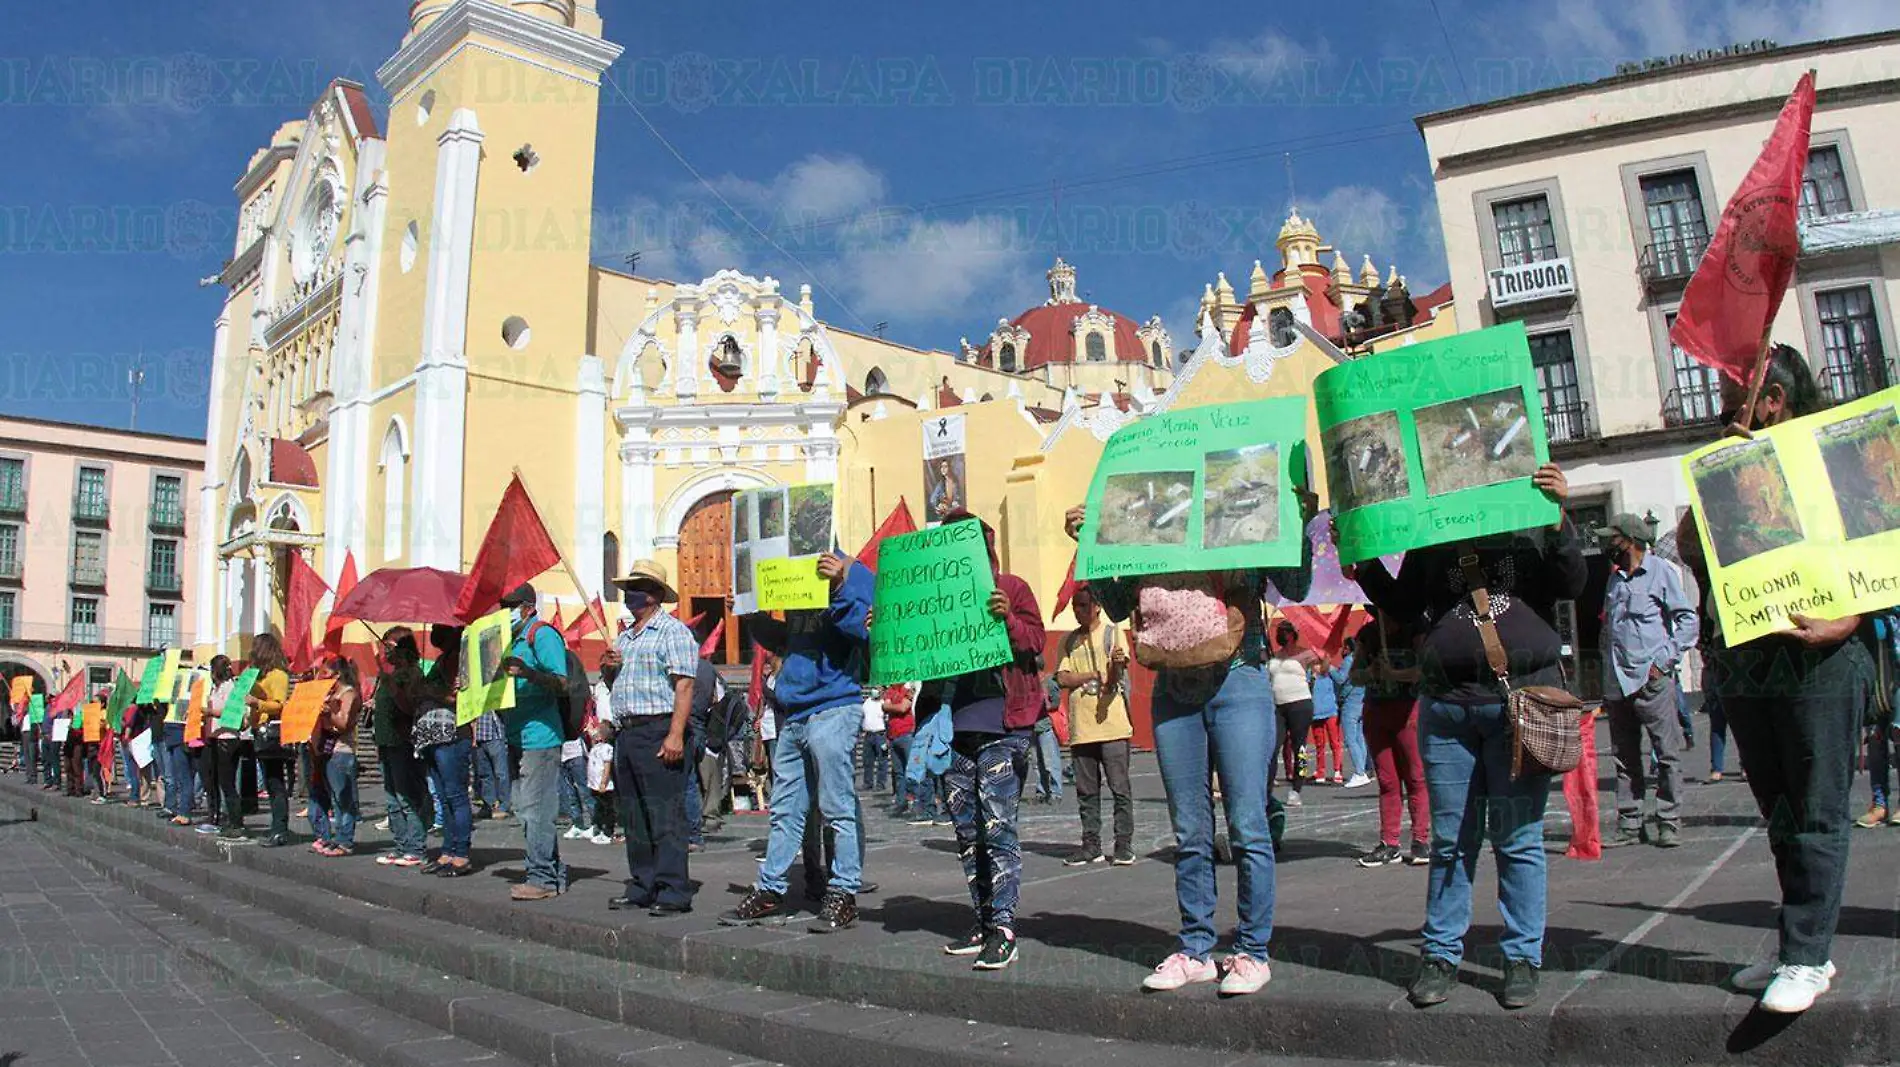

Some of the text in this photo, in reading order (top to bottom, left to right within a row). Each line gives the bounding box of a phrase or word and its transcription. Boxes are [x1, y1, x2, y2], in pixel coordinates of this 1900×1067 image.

[1490, 264, 1568, 297] TRIBUNA
[960, 575, 977, 608] el
[1722, 570, 1801, 607] COLONIA
[1734, 588, 1835, 632] AMPLIACIÓN
[915, 606, 1004, 653] autoridades
